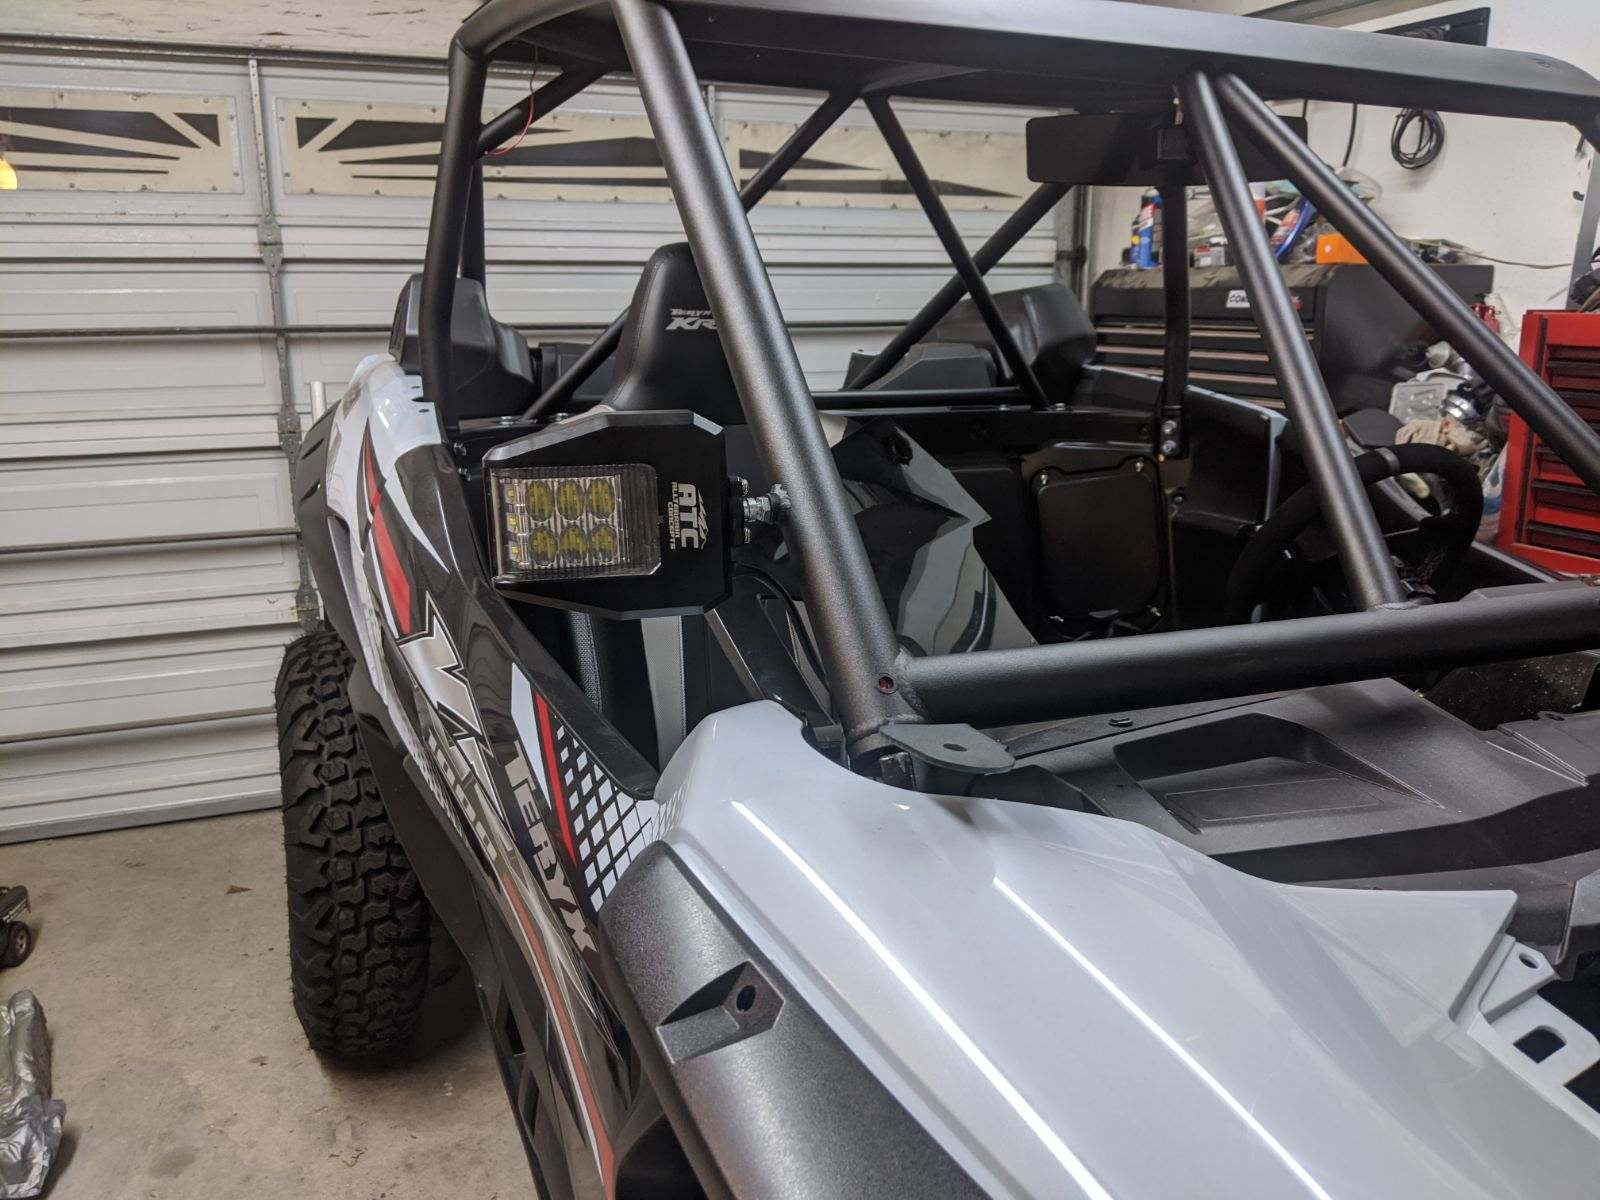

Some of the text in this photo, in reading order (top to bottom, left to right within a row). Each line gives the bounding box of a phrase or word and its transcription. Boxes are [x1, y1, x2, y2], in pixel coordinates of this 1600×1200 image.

[668, 502, 677, 550] CONCEPTS
[679, 484, 700, 549] ATC
[505, 740, 598, 952] TERYX
